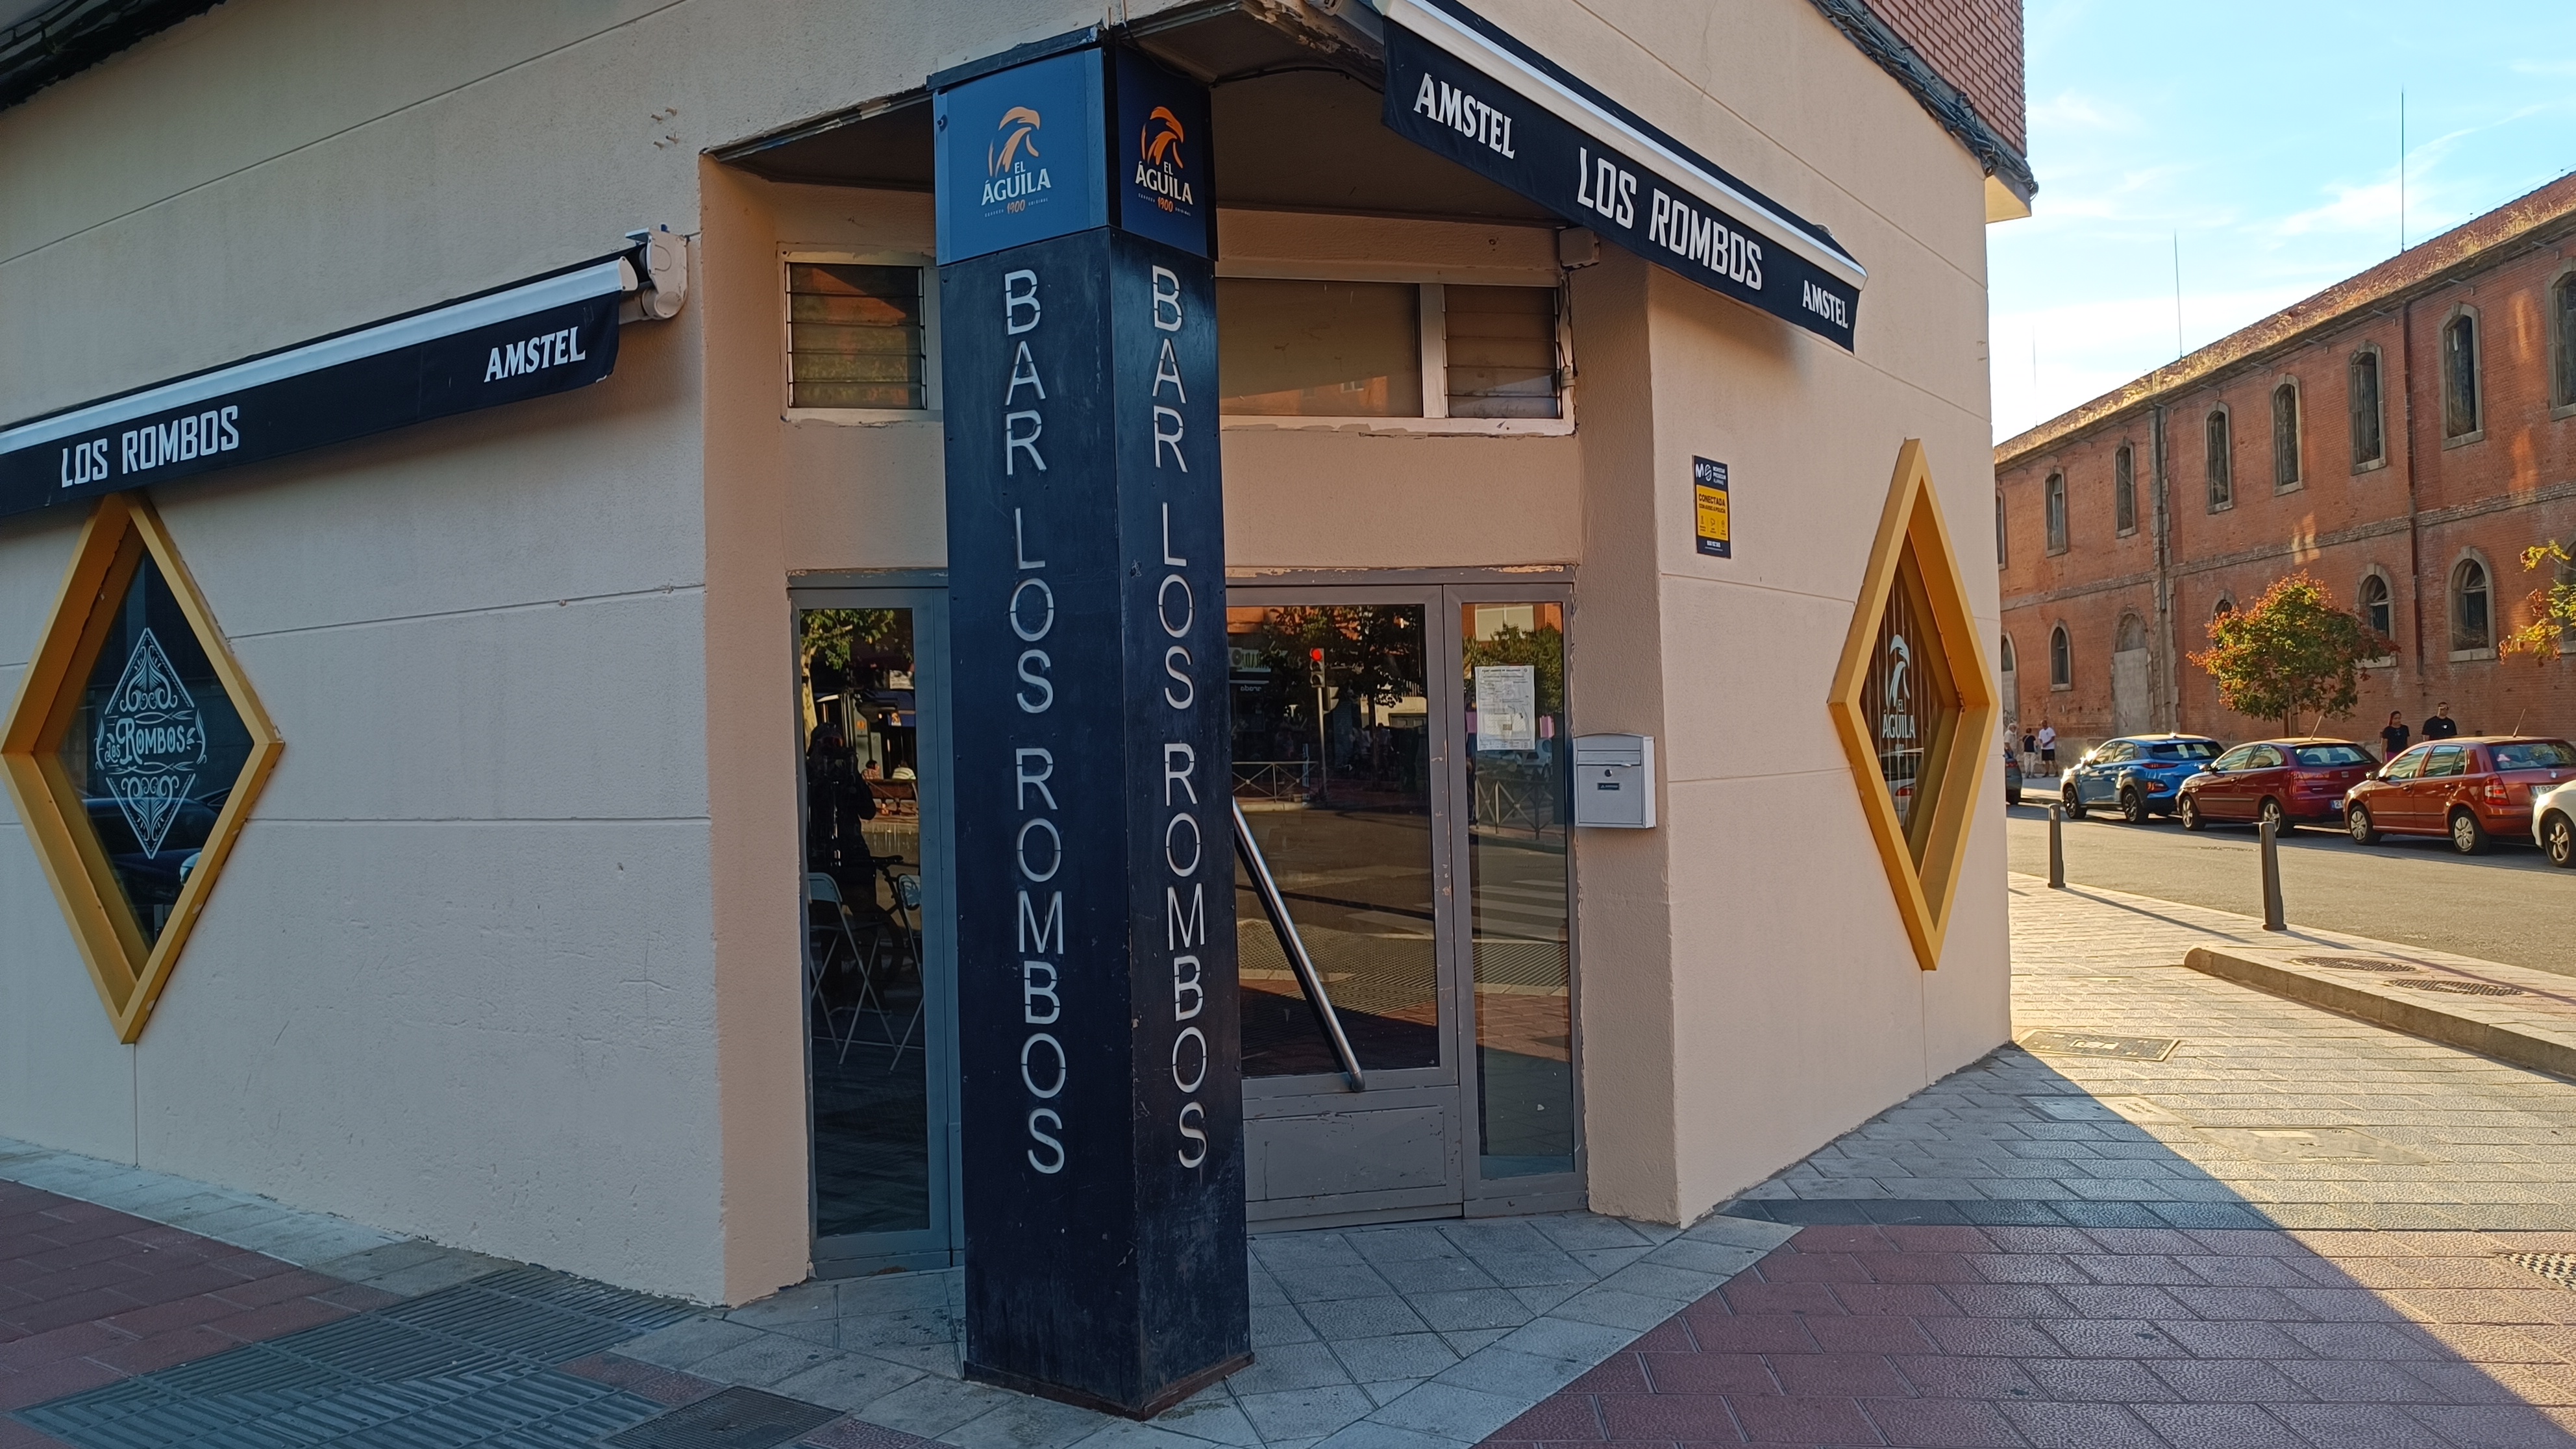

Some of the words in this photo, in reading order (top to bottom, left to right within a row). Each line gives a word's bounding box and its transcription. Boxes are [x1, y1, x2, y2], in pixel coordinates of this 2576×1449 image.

[1413, 73, 1515, 159] AMSTEL
[981, 168, 1052, 206] ÁGUILA
[1014, 160, 1026, 174] EL
[1135, 160, 1193, 205] ÁGUILA
[1163, 161, 1174, 175] EL
[1007, 199, 1026, 214] 1900
[1158, 196, 1173, 212] 1900
[1578, 147, 1637, 229] LOS
[1649, 188, 1763, 290] ROMBOS
[1802, 279, 1849, 329] AMSTEL
[484, 326, 586, 383] AMSTEL
[1004, 269, 1047, 475] BAR
[1152, 265, 1188, 473] BAR
[60, 438, 108, 488] LOS
[121, 405, 240, 475] ROMBOS
[1698, 493, 1726, 506] CONECTADA
[1009, 508, 1054, 713] LOS
[1158, 502, 1195, 710] LOS
[1882, 709, 1916, 738] ÁGUILA
[1898, 699, 1904, 712] EL
[1016, 747, 1067, 1174] ROMBOS
[1164, 743, 1209, 1169] ROMBOS
